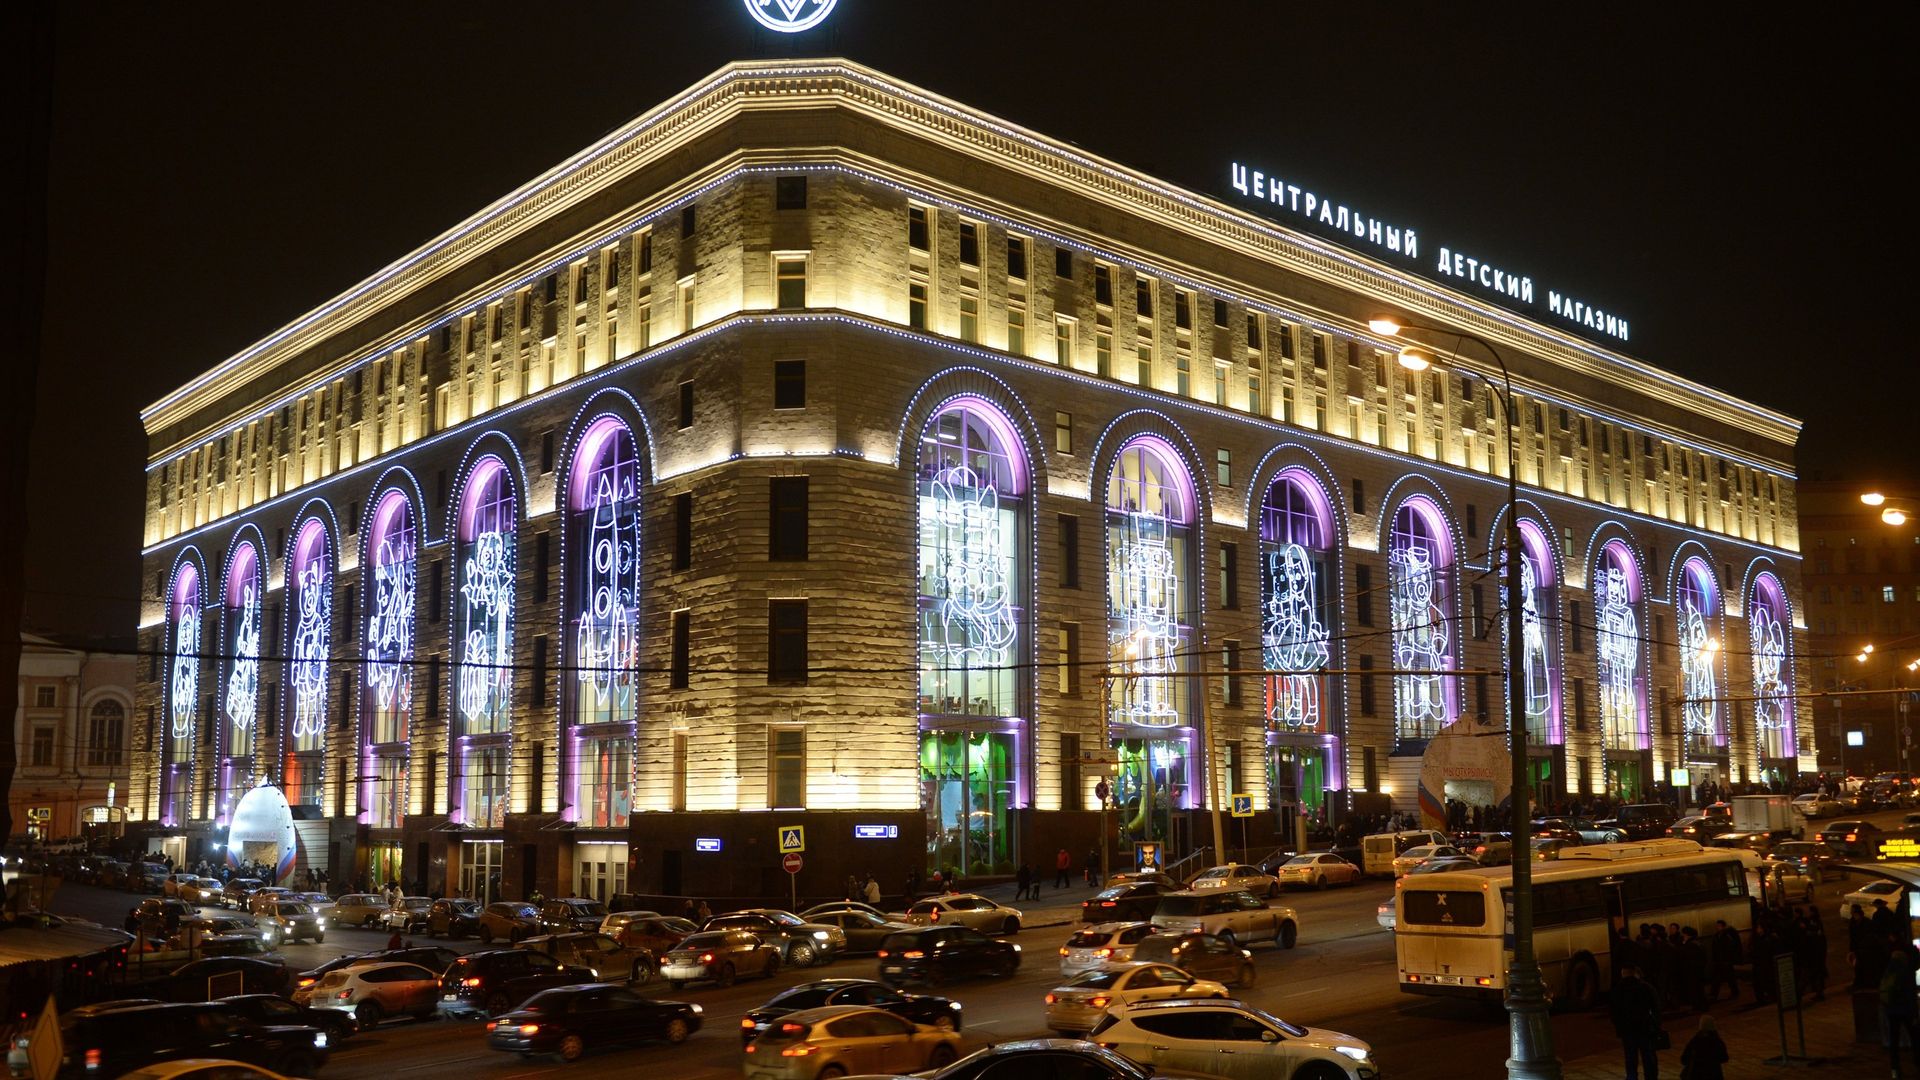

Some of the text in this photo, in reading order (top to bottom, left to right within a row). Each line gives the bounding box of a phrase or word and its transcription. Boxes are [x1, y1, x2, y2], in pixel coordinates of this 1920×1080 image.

[1232, 162, 1629, 341] ЦЕНТРАЛЬНЫЙ ДЕТСКИЙ МАГАЗИН
